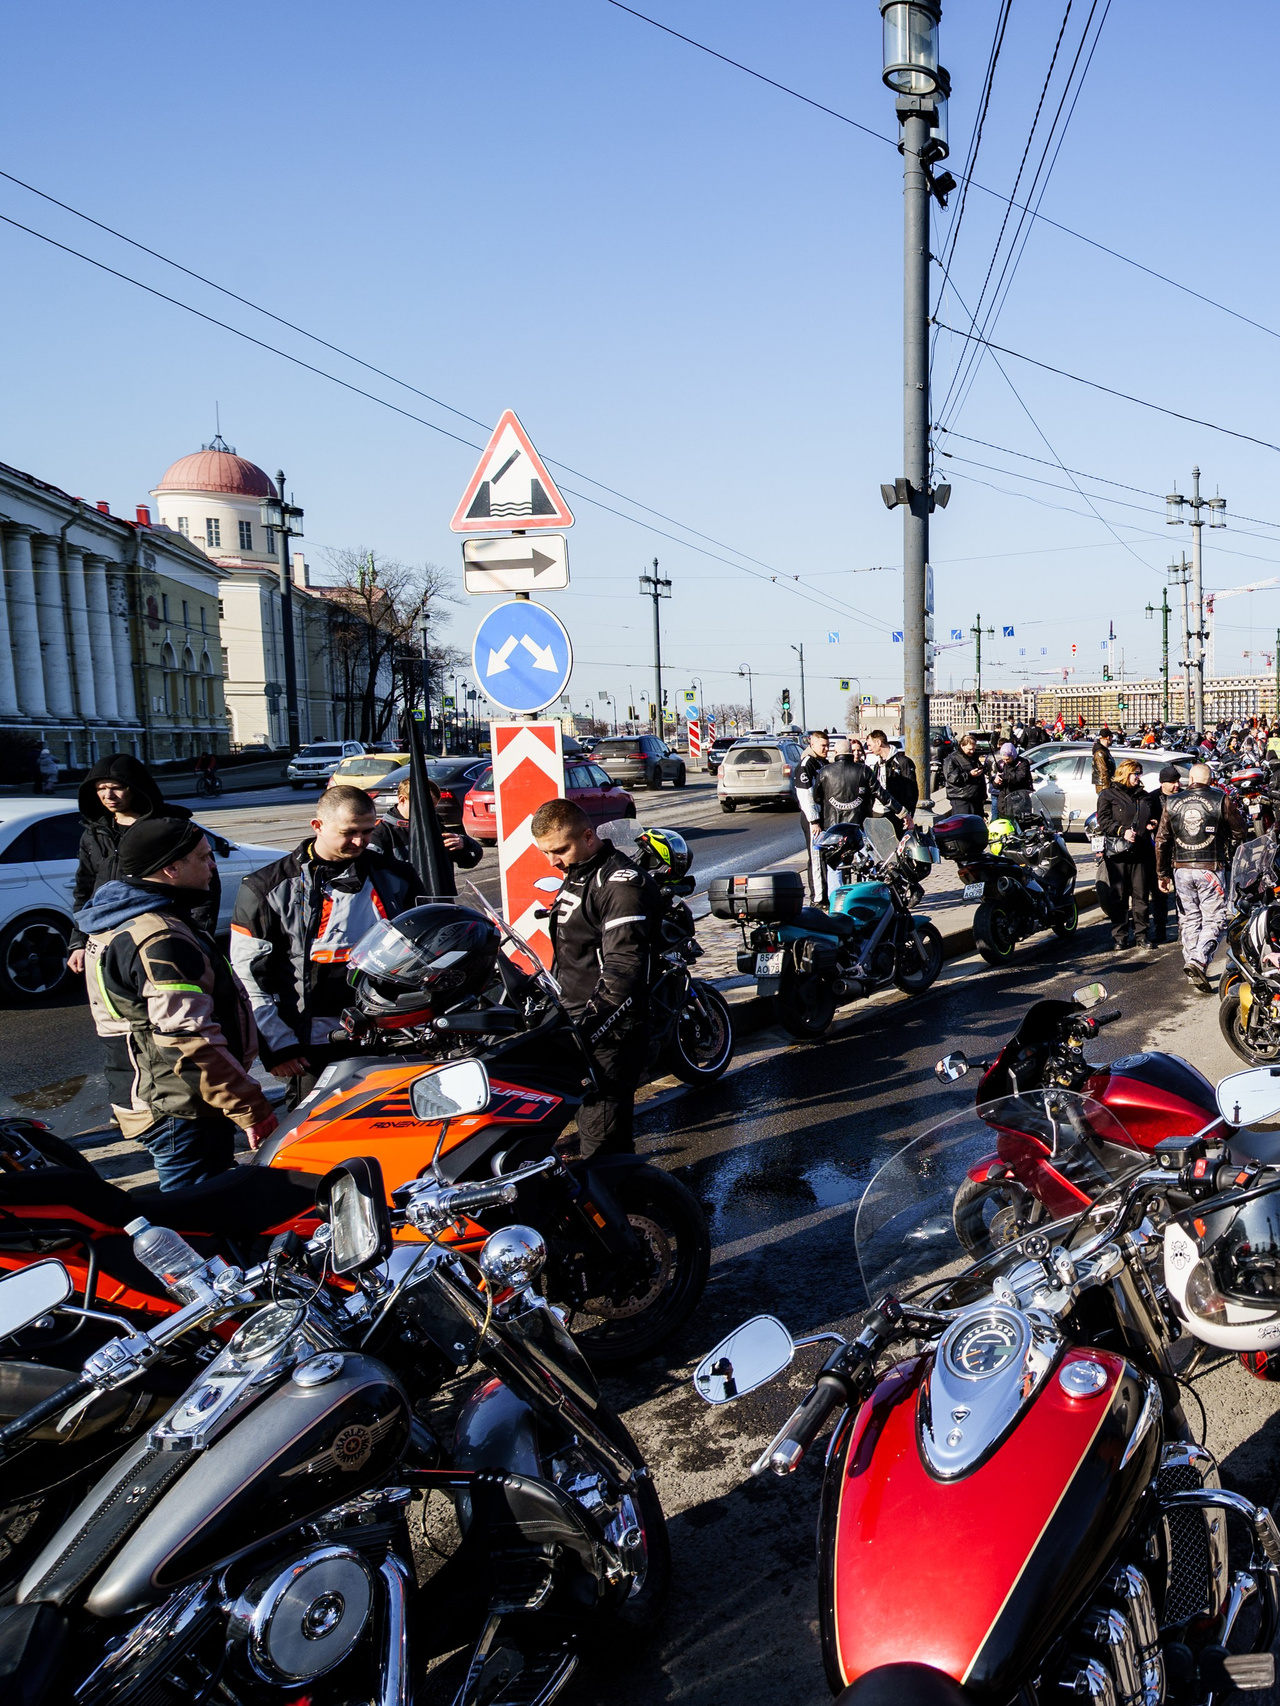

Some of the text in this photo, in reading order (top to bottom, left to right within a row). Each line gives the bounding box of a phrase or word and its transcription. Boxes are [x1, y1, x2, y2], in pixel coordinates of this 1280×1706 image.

[367, 949, 387, 970] SHARK
[760, 953, 780, 962] 8541
[757, 966, 769, 974] AO
[460, 1118, 480, 1126] S
